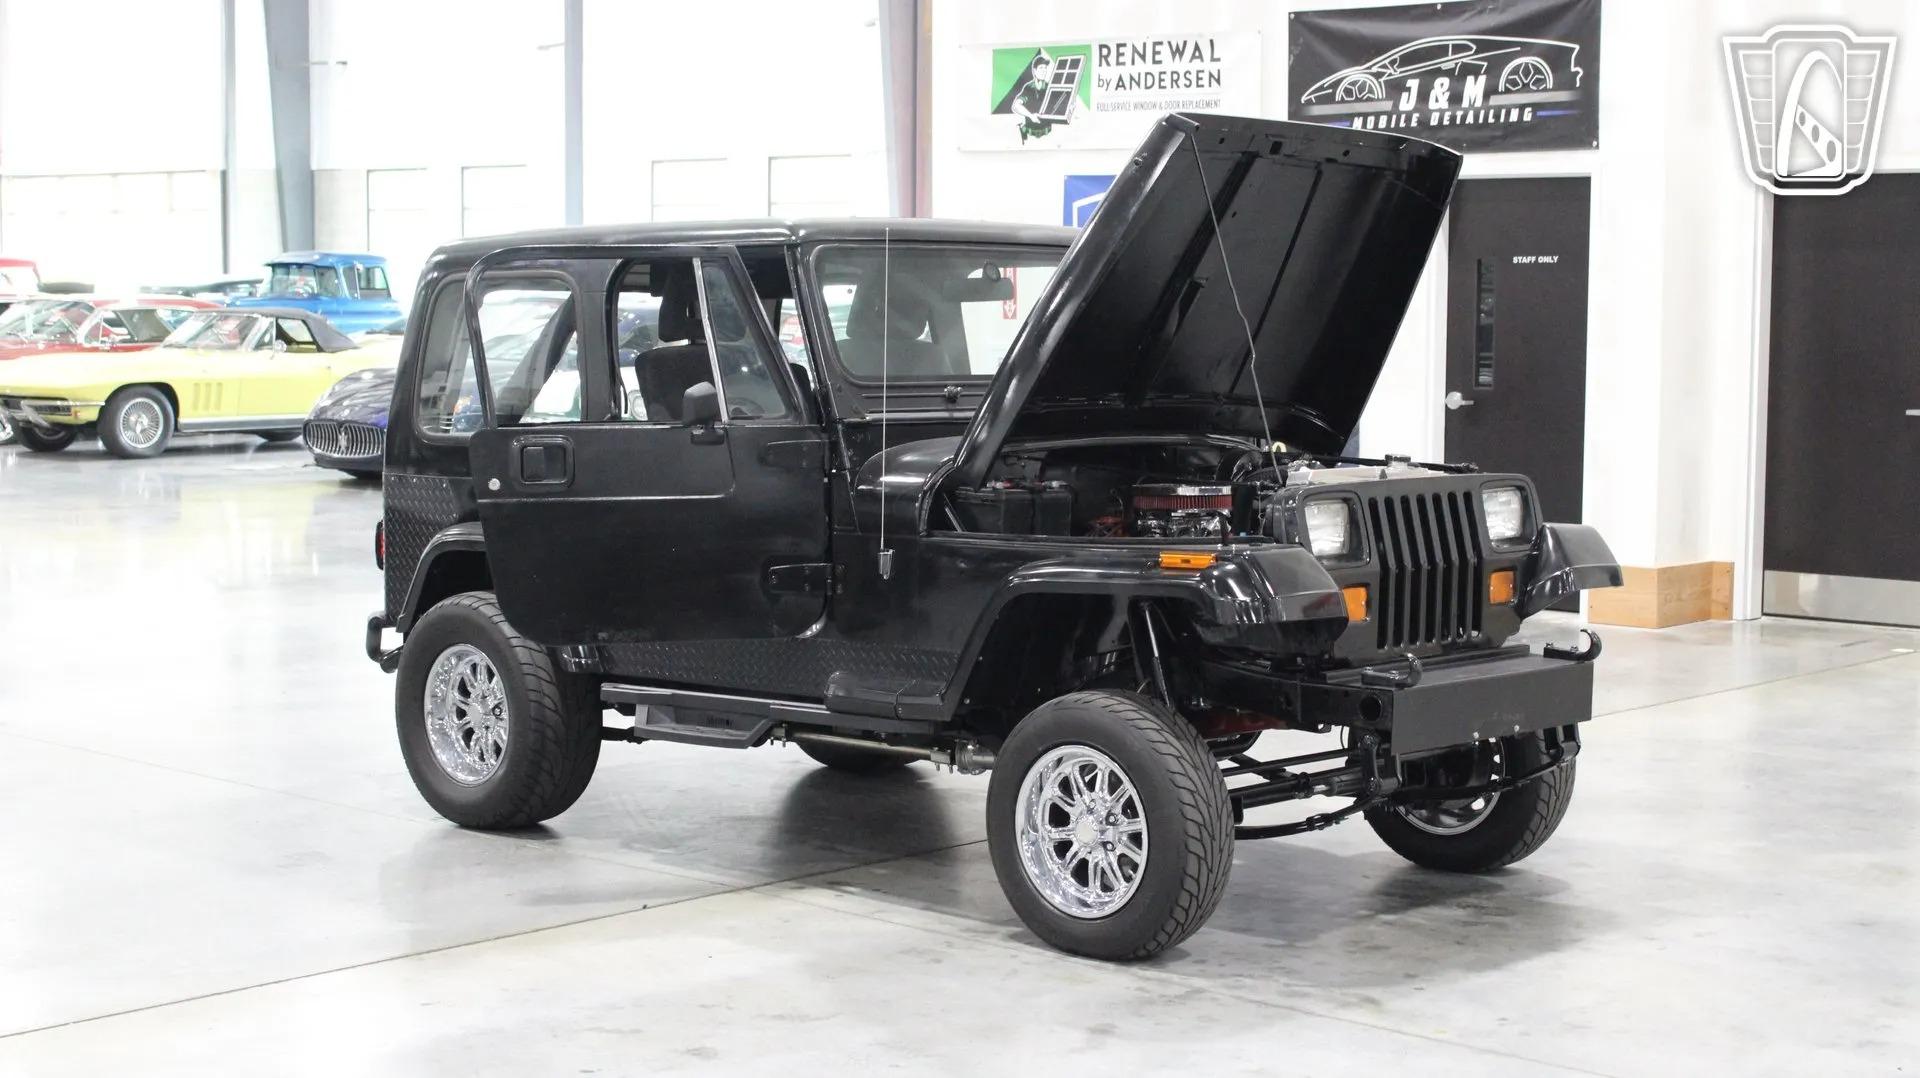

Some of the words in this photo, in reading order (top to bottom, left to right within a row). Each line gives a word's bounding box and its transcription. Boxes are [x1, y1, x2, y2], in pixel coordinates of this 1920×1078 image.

[1098, 39, 1221, 67] RENEWAL
[1097, 73, 1112, 91] by
[1114, 69, 1221, 91] ANDERSEN
[1399, 78, 1420, 111] J
[1428, 76, 1450, 110] &
[1461, 75, 1487, 108] M
[1133, 101, 1158, 111] WINDOW
[1159, 101, 1164, 111] &
[1165, 100, 1180, 110] DOOR
[1182, 99, 1221, 110] REPLACEMENT
[1352, 113, 1420, 130] MOBILE
[1429, 107, 1533, 127] DETAILING
[1512, 255, 1536, 264] STAFF
[1537, 255, 1559, 264] ONLY
